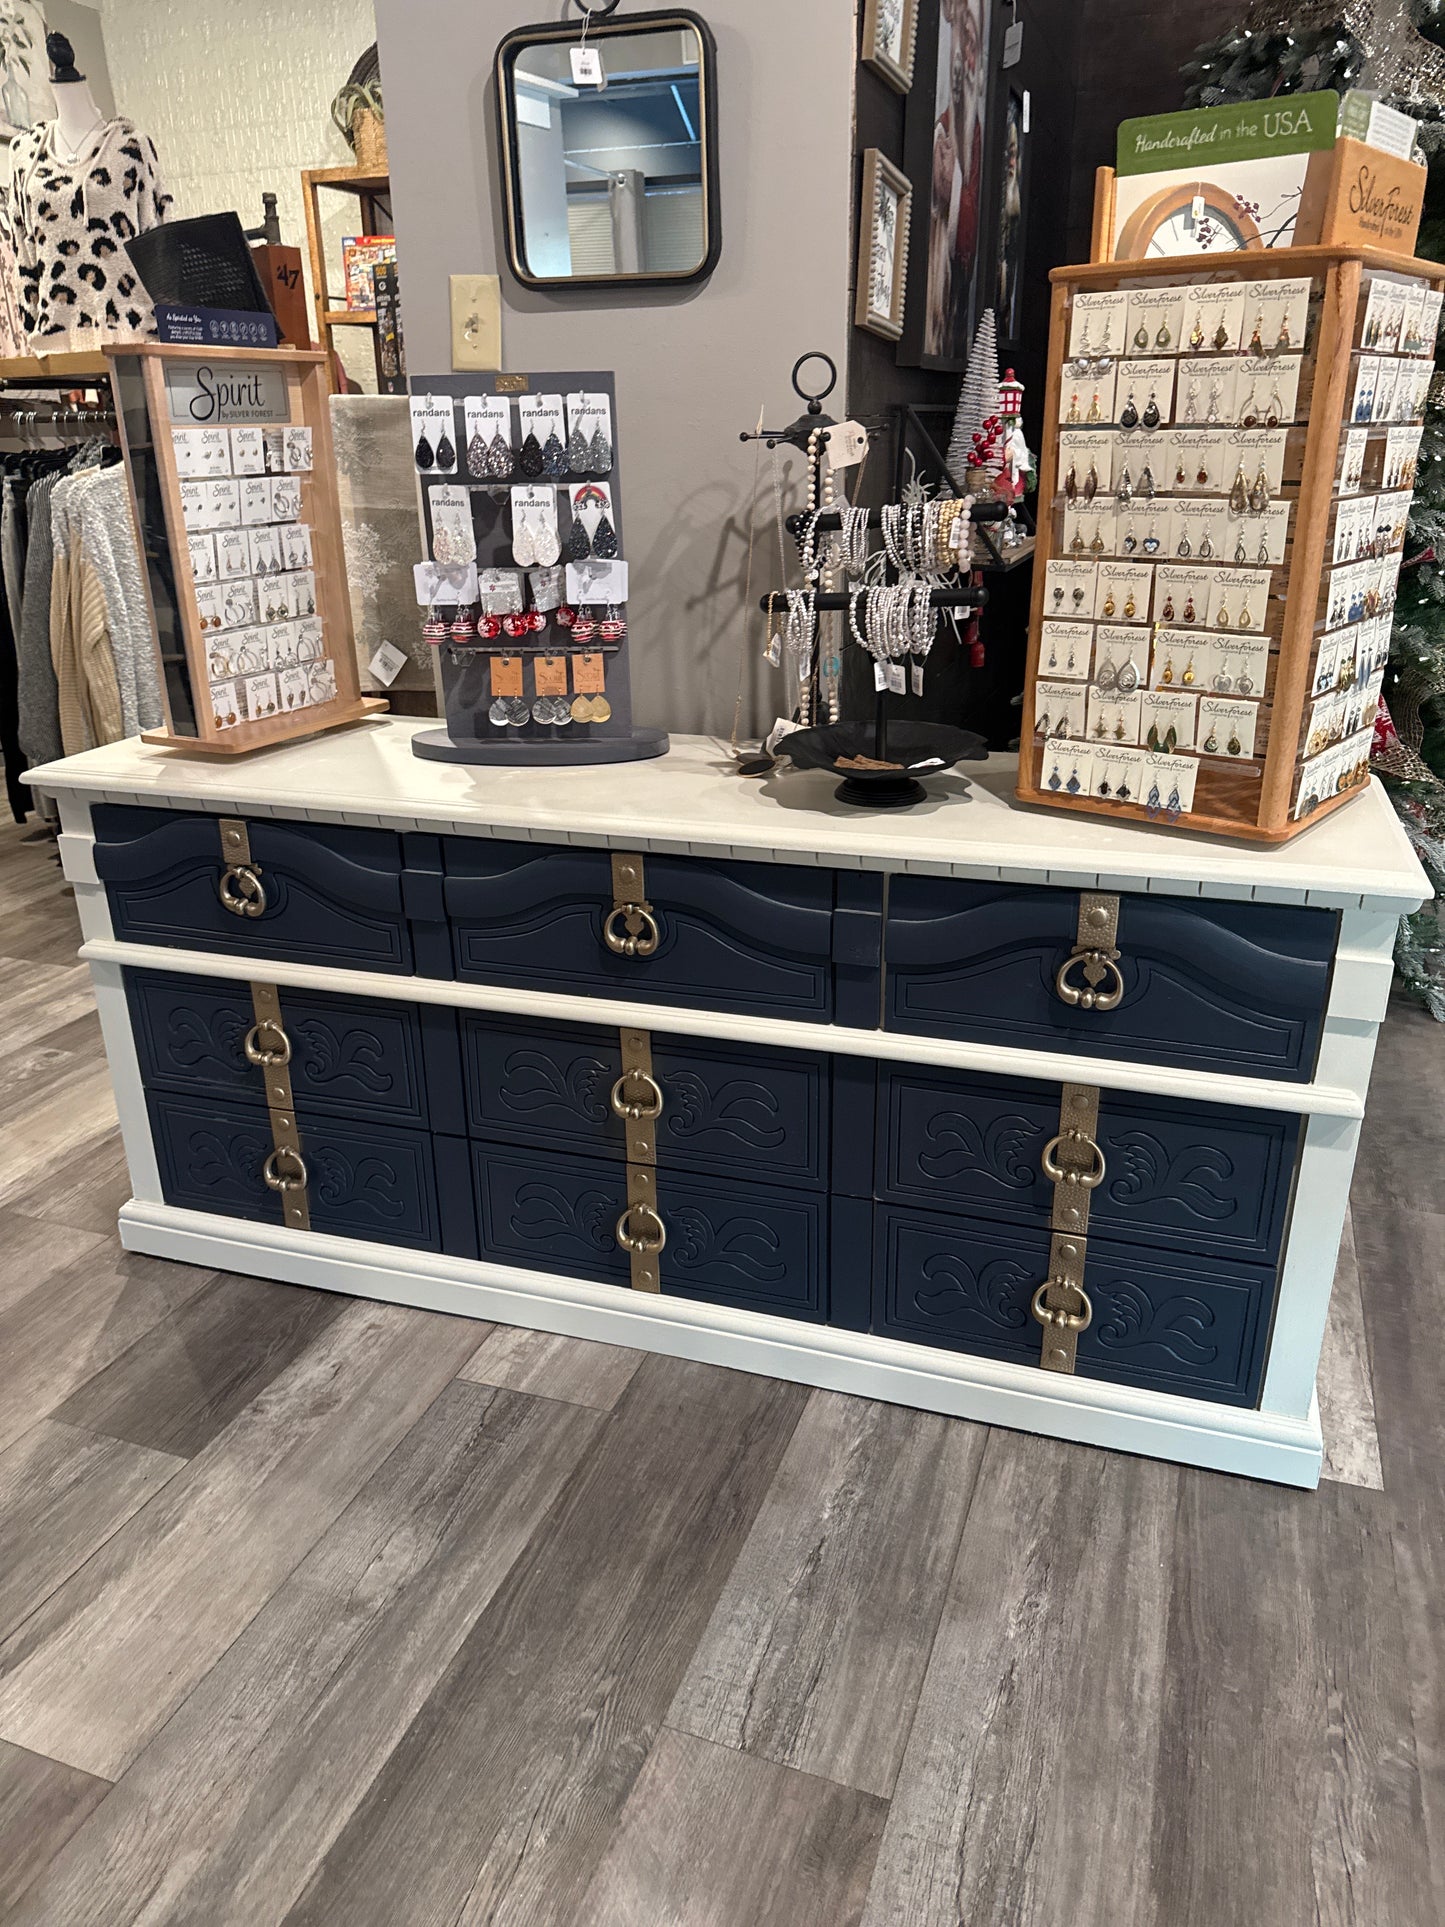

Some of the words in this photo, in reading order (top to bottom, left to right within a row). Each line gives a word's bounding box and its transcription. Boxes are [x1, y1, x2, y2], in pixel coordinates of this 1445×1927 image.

[1134, 124, 1218, 152] Handcrafted
[1220, 126, 1232, 140] in
[1236, 120, 1258, 138] the
[1264, 109, 1312, 138] USA
[190, 366, 265, 422] Spirit
[222, 411, 229, 419] by
[230, 410, 250, 418] SILVER
[252, 410, 273, 418] FOREST
[413, 409, 450, 418] randans
[468, 410, 504, 419] randans
[522, 409, 559, 418] randans
[570, 407, 606, 416] randans
[432, 499, 464, 508] randans
[514, 499, 550, 508] randans
